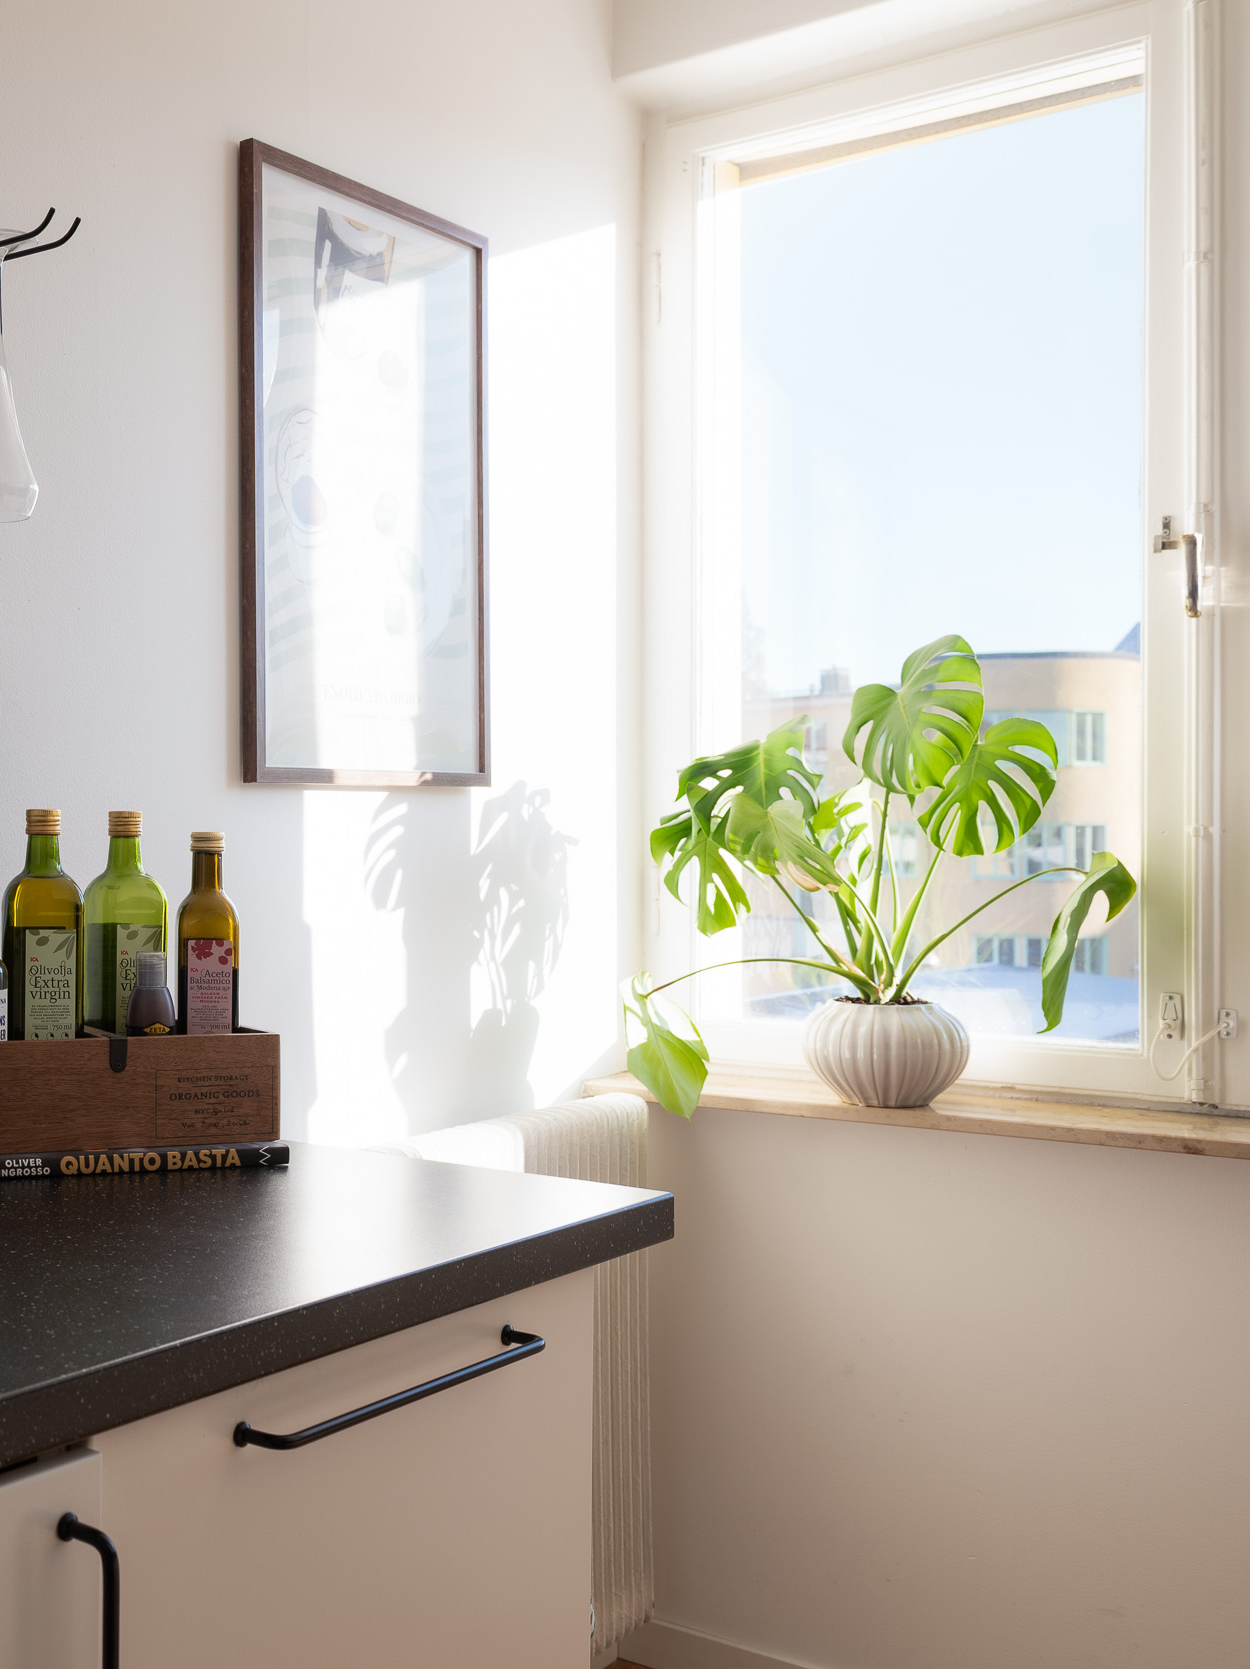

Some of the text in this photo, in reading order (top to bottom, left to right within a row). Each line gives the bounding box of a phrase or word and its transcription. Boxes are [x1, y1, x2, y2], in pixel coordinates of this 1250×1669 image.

[201, 969, 230, 978] Aceto
[29, 976, 70, 989] Extra
[30, 989, 71, 1003] virgin
[51, 1024, 63, 1032] 750
[177, 1075, 212, 1083] KITCHEN
[169, 1089, 261, 1101] ORGANIC GOODS
[5, 1158, 42, 1168] OLIVER
[60, 1148, 241, 1176] QUANTO BASTA
